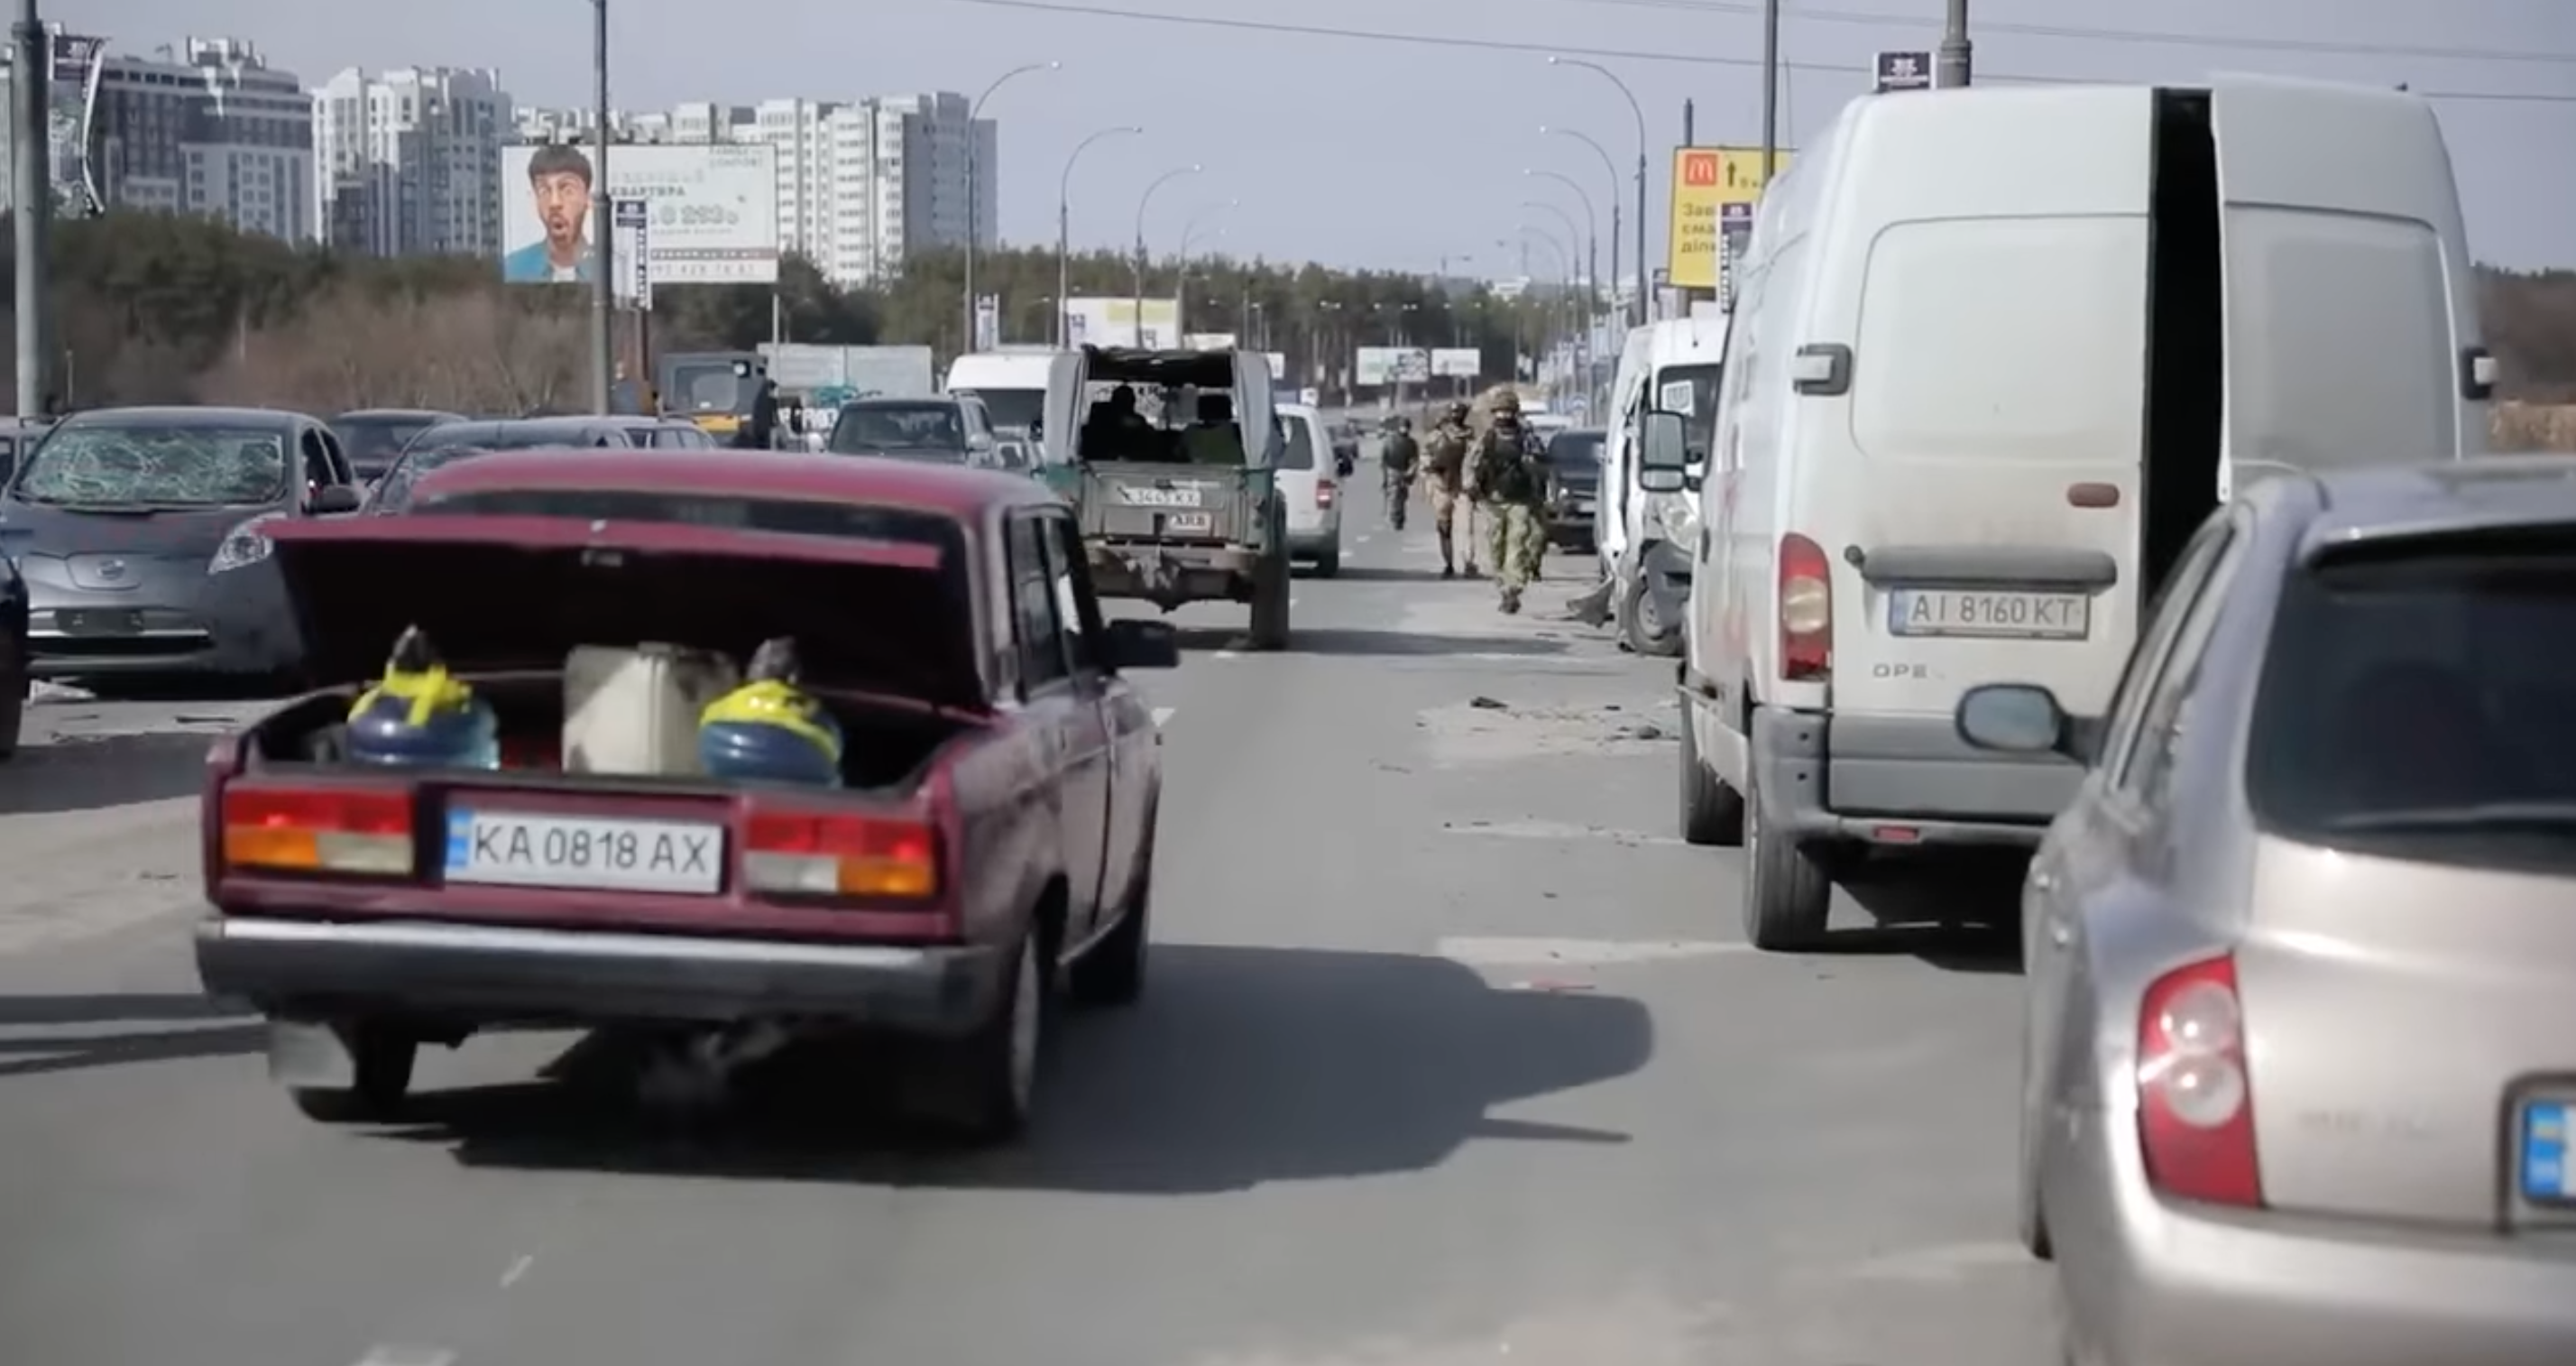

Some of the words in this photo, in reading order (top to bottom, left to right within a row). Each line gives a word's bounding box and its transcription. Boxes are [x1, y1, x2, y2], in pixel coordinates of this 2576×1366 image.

[1911, 595, 1946, 623] AI
[1959, 595, 2027, 624] 8160
[2033, 598, 2075, 627] KT
[1872, 663, 1945, 678] OPE
[474, 824, 532, 864] KA
[544, 827, 638, 869] 0818
[649, 832, 708, 874] AX
